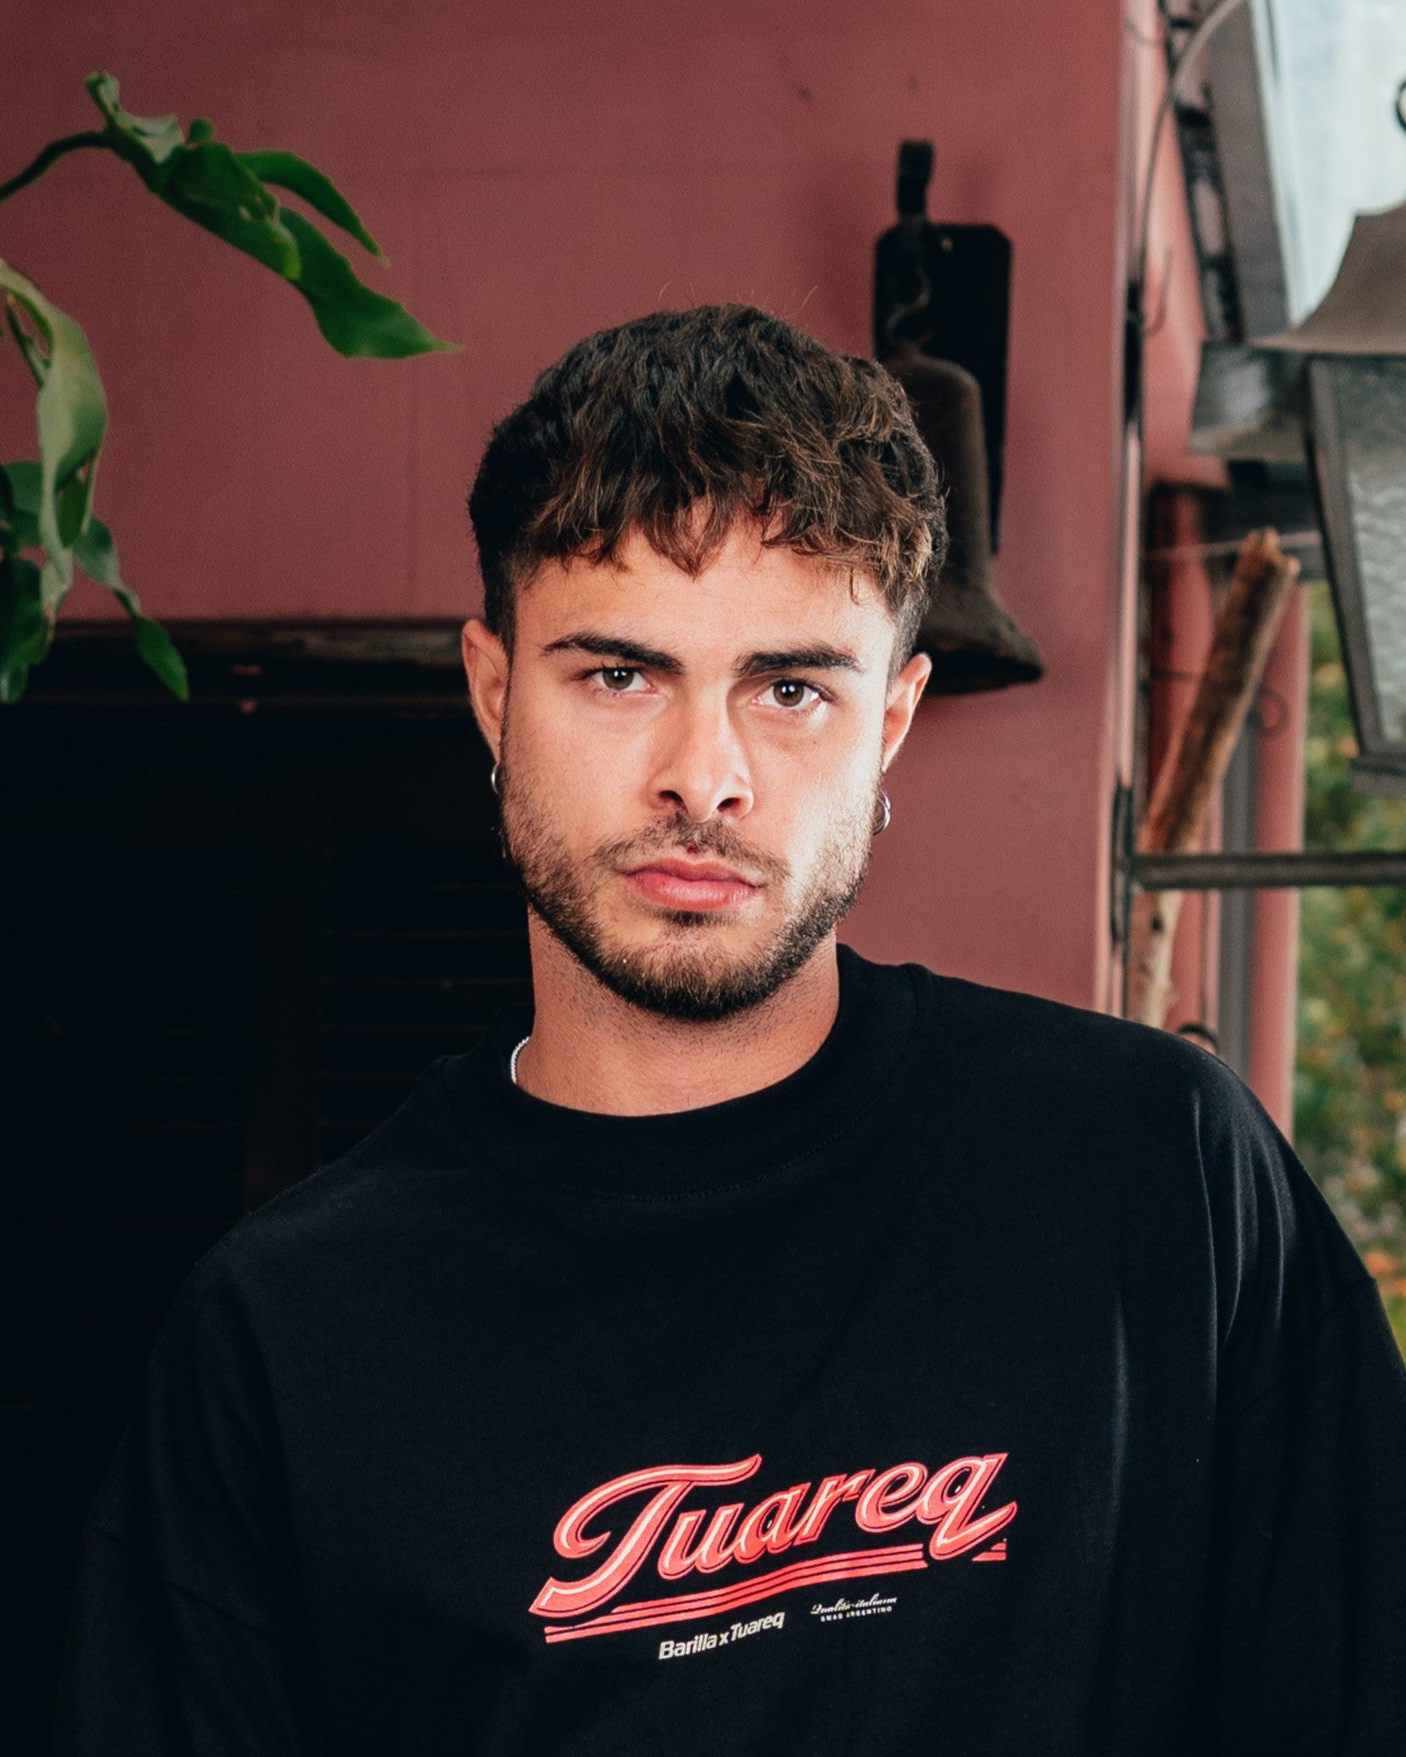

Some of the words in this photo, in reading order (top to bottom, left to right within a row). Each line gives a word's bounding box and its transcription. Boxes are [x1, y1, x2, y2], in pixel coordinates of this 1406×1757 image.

[846, 1606, 892, 1618] ARGENTINO
[658, 1633, 717, 1660] Barilla
[730, 1612, 785, 1641] Tuareq
